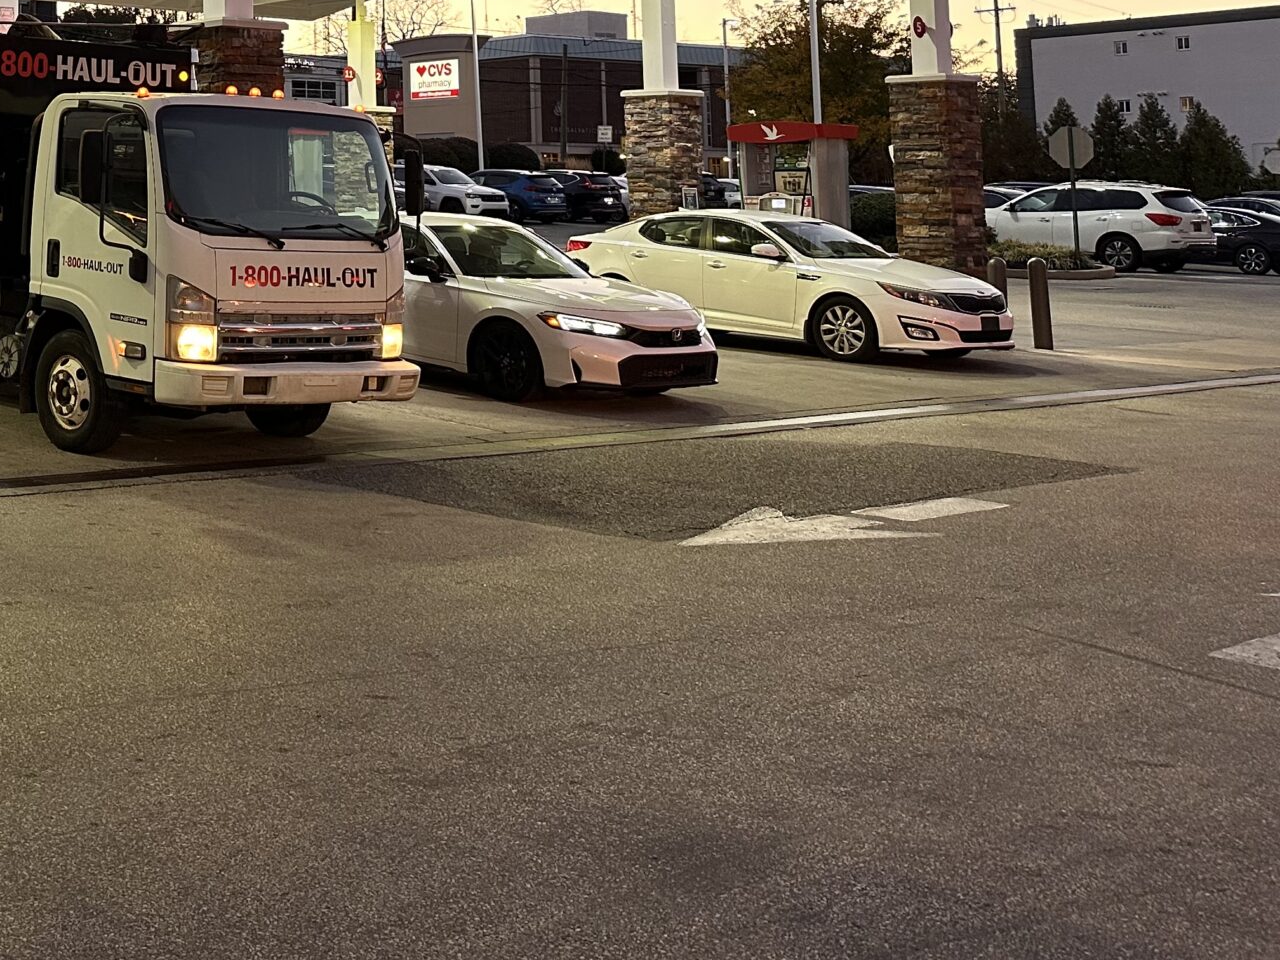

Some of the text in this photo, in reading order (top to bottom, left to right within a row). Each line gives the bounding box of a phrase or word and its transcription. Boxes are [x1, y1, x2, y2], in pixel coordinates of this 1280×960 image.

[916, 21, 922, 33] 5
[345, 69, 354, 79] 11
[428, 62, 452, 77] CVS
[418, 79, 452, 90] pharmacy
[62, 255, 124, 275] 1-800-HAUL-OUT
[230, 265, 378, 288] 1-800-HAUL-OUT
